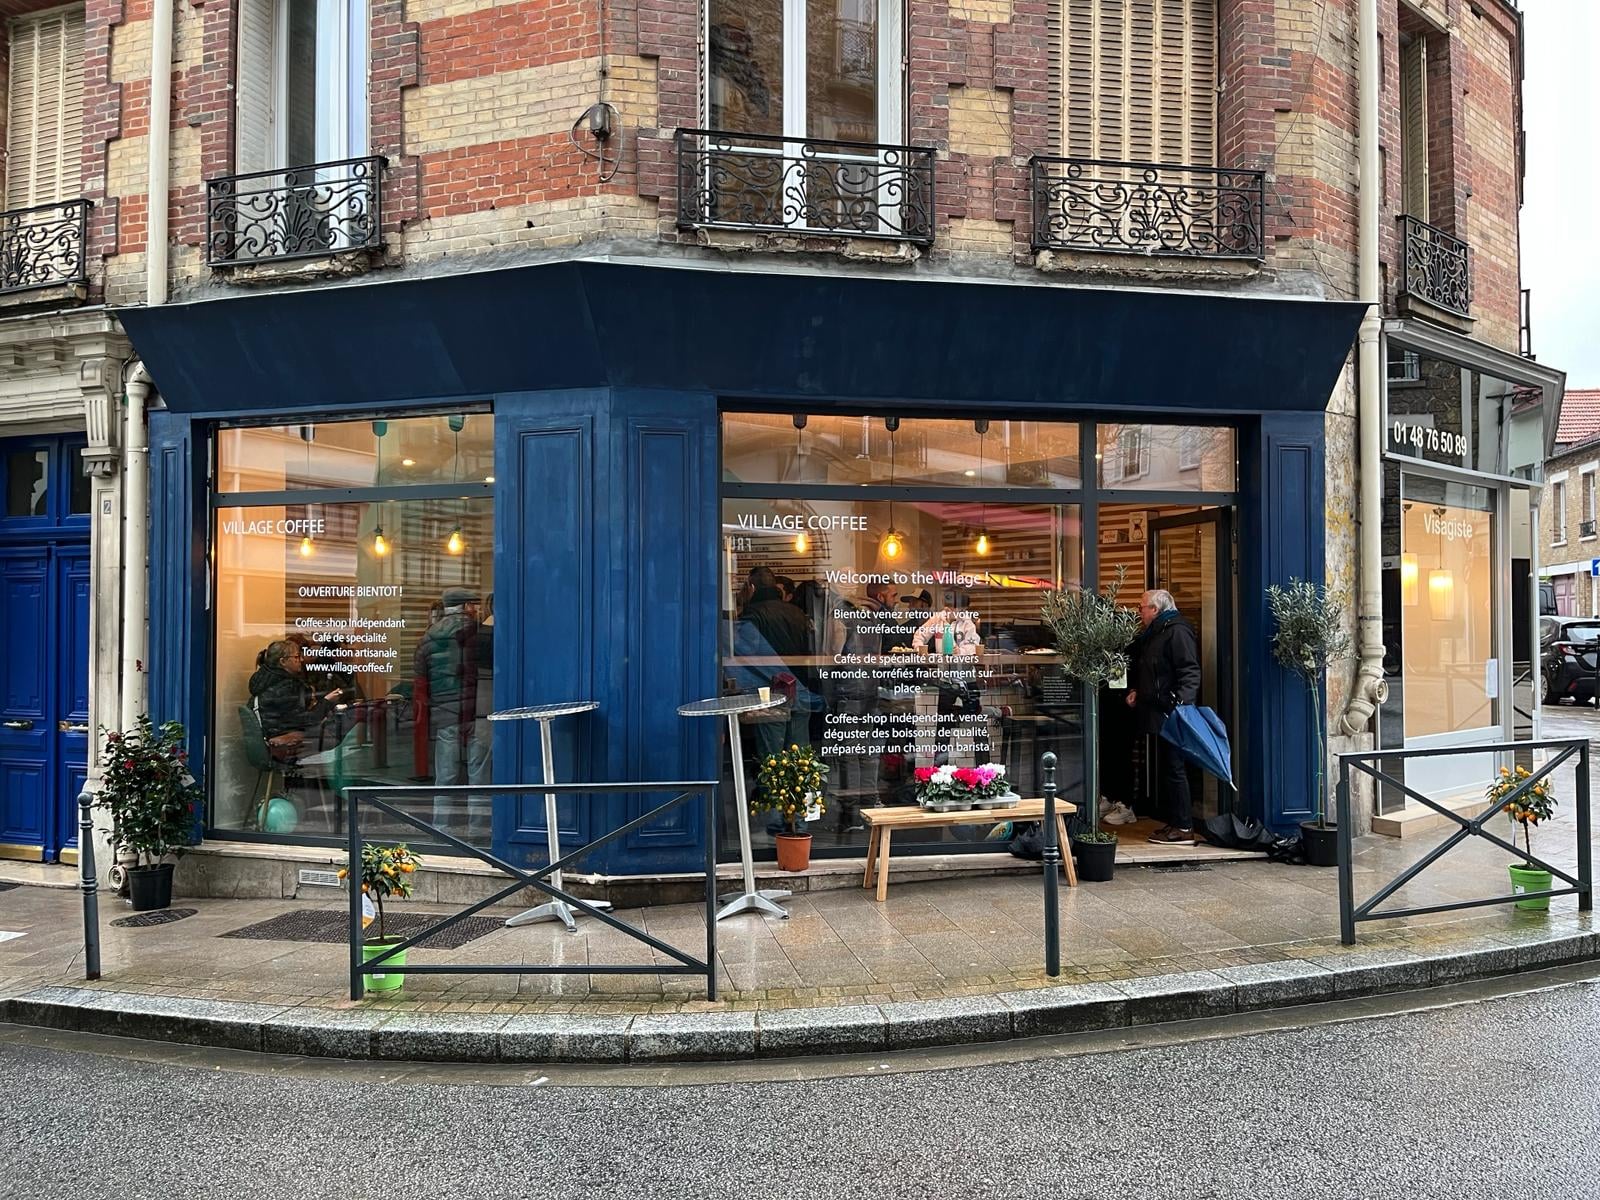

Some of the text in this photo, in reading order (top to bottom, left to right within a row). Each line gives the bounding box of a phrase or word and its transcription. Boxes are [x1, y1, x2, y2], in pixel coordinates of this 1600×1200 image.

[1393, 420, 1467, 457] 01 48 76 50 89
[104, 501, 111, 513] 2
[222, 519, 325, 535] VILLAGE COFFEE
[737, 513, 868, 531] VILLAGE COFFEE
[1423, 513, 1473, 541] Visagiste
[825, 570, 889, 585] Welcome
[893, 572, 908, 585] to
[911, 571, 934, 585] the
[935, 570, 983, 588] Village
[298, 586, 355, 597] OUVERTURE
[357, 586, 398, 597] BIENTOT
[834, 608, 980, 620] Bientôt venez retrouver votre
[295, 617, 406, 629] Coffee-shop Indépendant
[856, 623, 917, 635] torréfacteur
[312, 632, 332, 642] Café
[332, 632, 345, 642] de
[302, 646, 398, 658] Torréfaction artisanale
[833, 652, 862, 664] Cafés
[863, 653, 877, 664] de
[878, 652, 927, 667] spécialité
[945, 654, 979, 664] travers
[305, 661, 393, 674] www.villagecoffee.fr
[819, 668, 829, 679] le
[871, 667, 914, 678] torréfiés
[915, 667, 976, 679] fraichement
[977, 669, 993, 678] sur
[893, 682, 923, 696] place.
[825, 713, 888, 726] Coffee-shop
[958, 713, 989, 722] venez
[823, 726, 990, 743] déguster des boissons de qualité,
[821, 743, 867, 757] préparés
[868, 745, 885, 757] par
[887, 744, 901, 753] un
[902, 741, 954, 756] champion
[955, 740, 990, 751] barista
